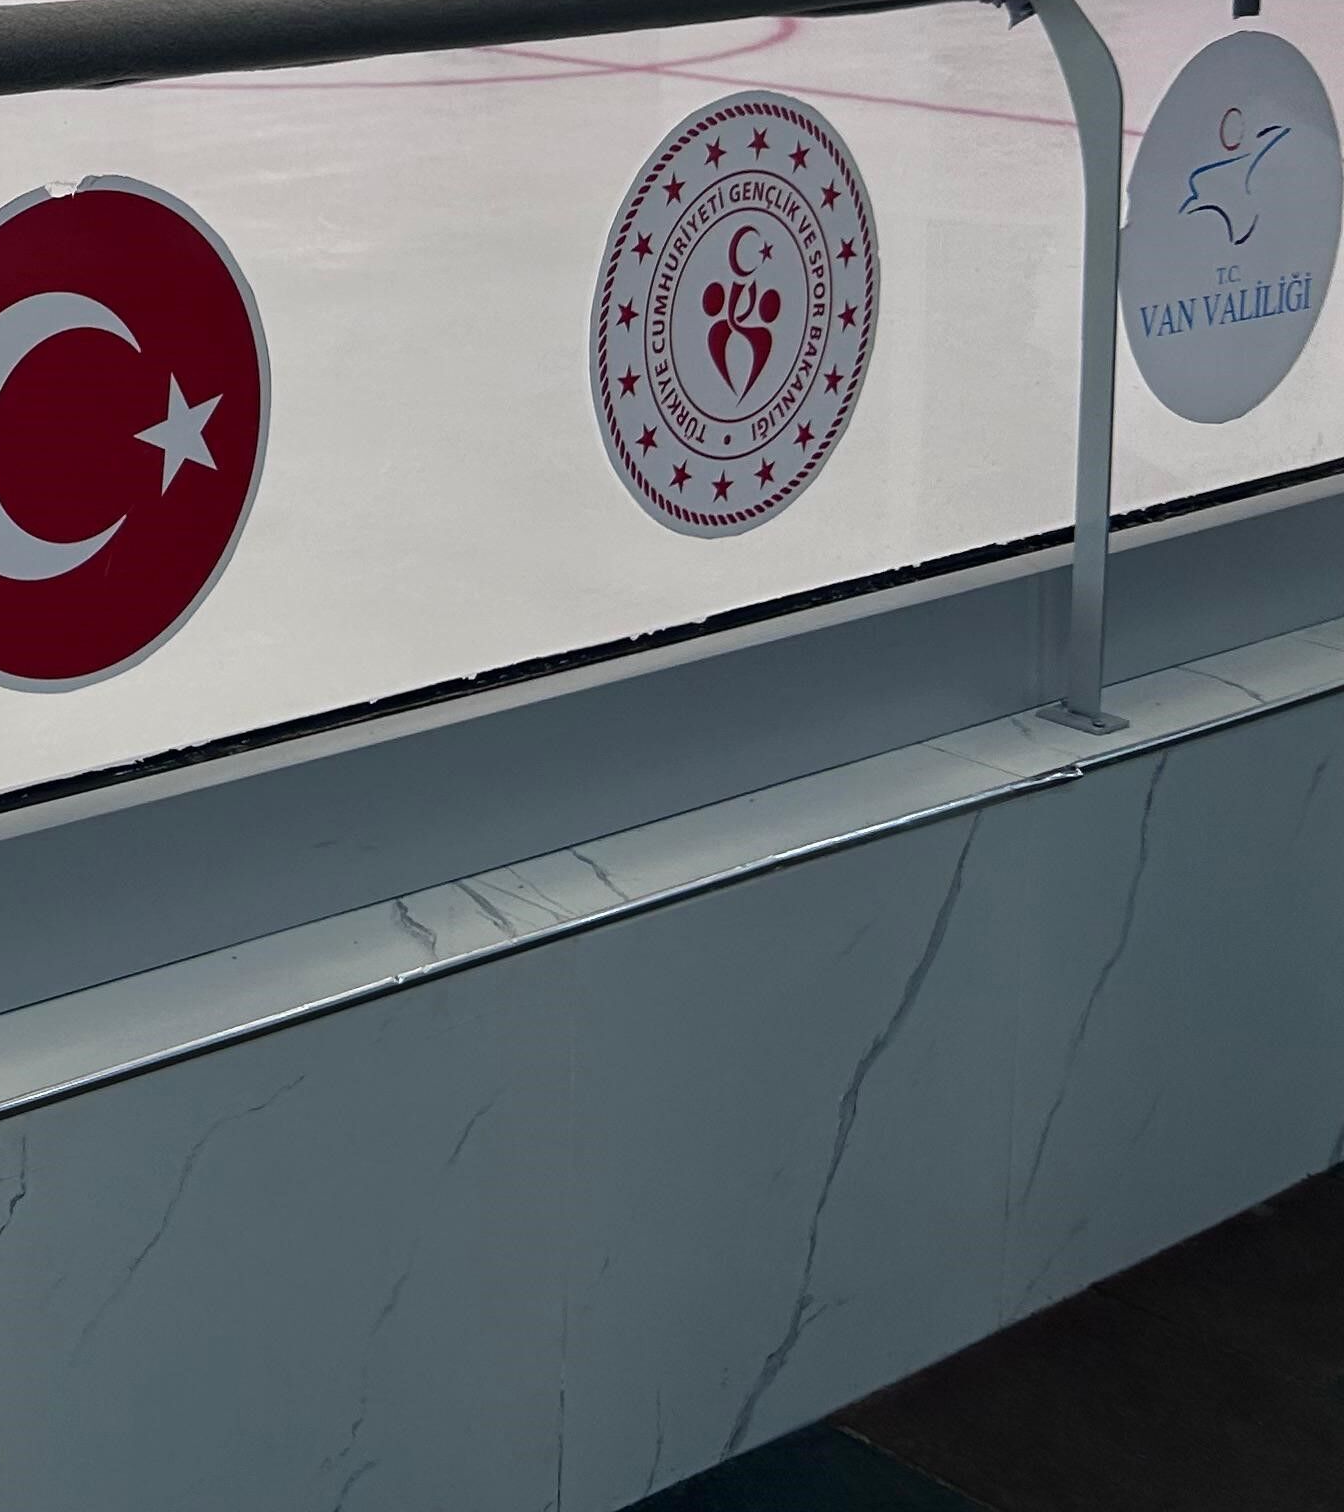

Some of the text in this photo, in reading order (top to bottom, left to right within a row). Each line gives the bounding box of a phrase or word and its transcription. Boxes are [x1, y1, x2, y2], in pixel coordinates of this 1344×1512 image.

[652, 180, 827, 445] TÜRKİYE CUMHURİYETİ GENÇLİK VE SPOR BAKANLIĞI
[1140, 272, 1312, 338] VAN VALİLİĞİ
